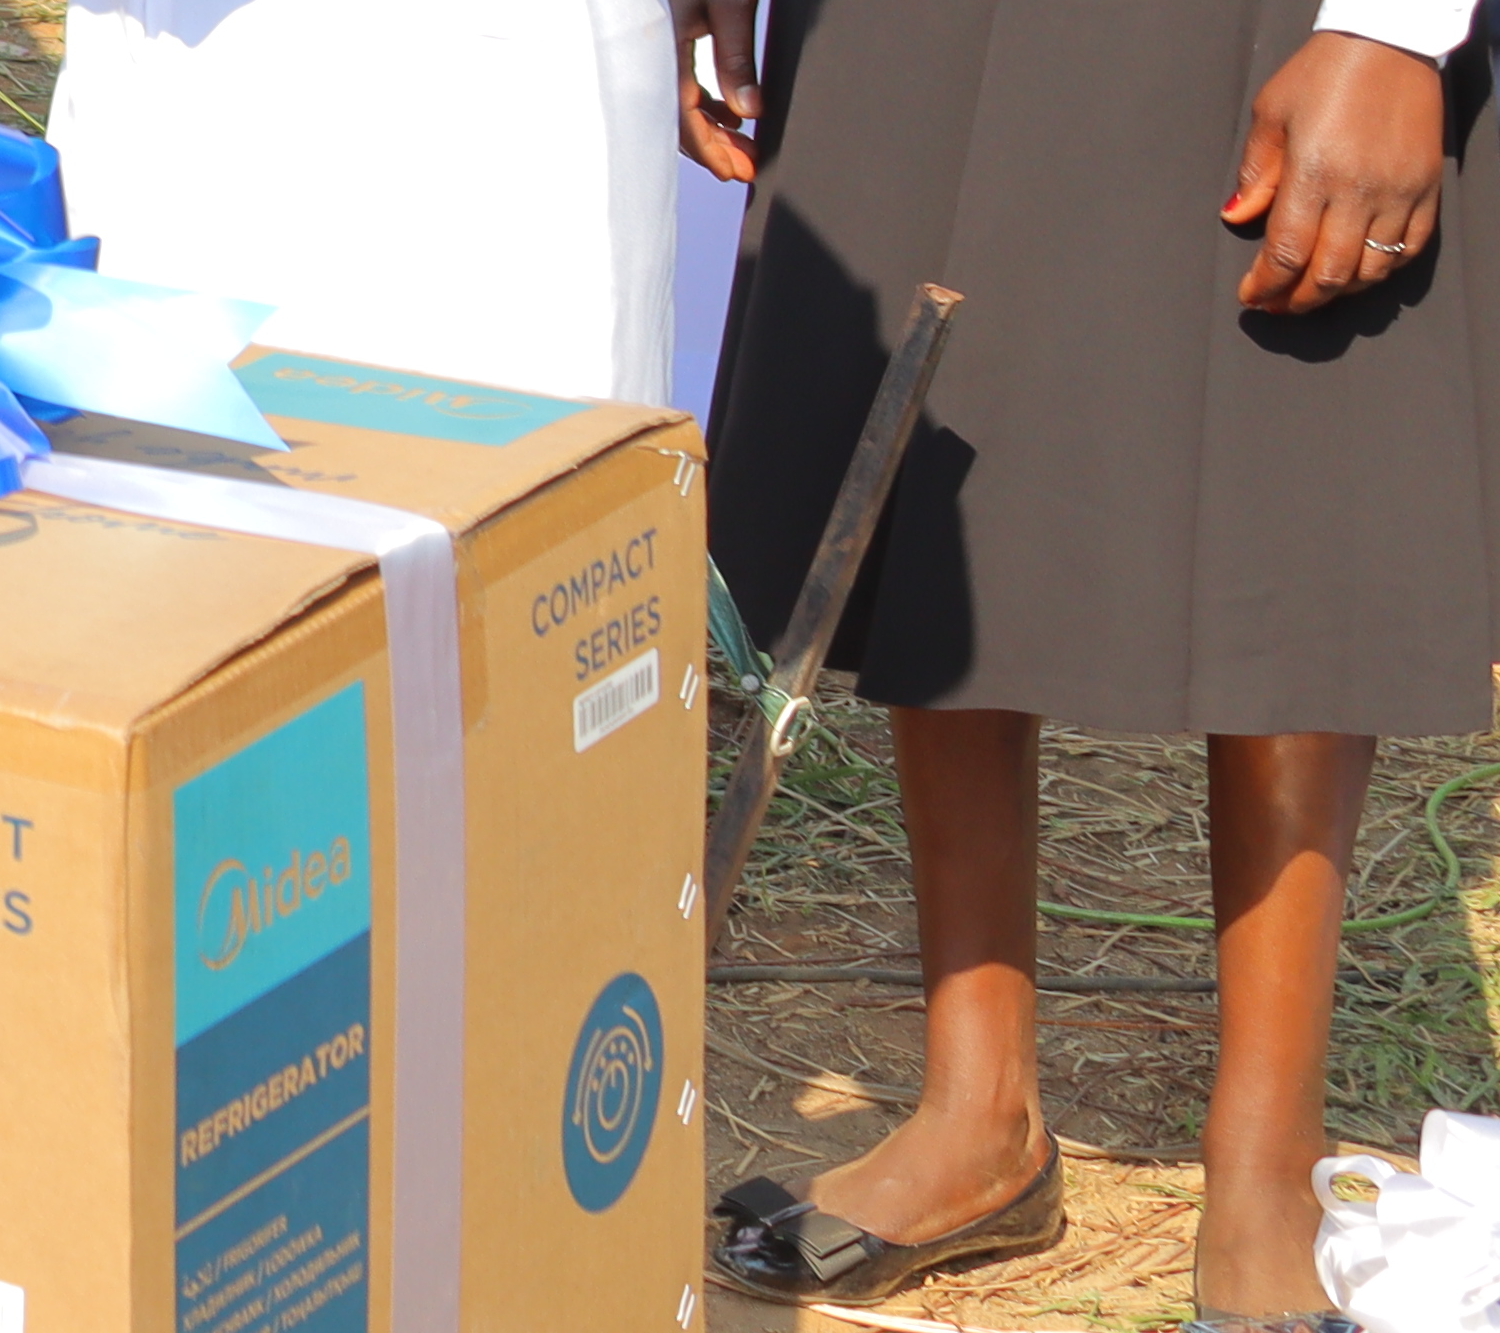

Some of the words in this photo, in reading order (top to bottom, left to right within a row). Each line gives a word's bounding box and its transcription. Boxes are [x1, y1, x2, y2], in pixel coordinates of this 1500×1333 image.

[532, 528, 657, 637] COMPACT
[575, 595, 661, 681] SERIES
[197, 835, 351, 971] Midea
[180, 1022, 365, 1167] REFRIGERATOR
